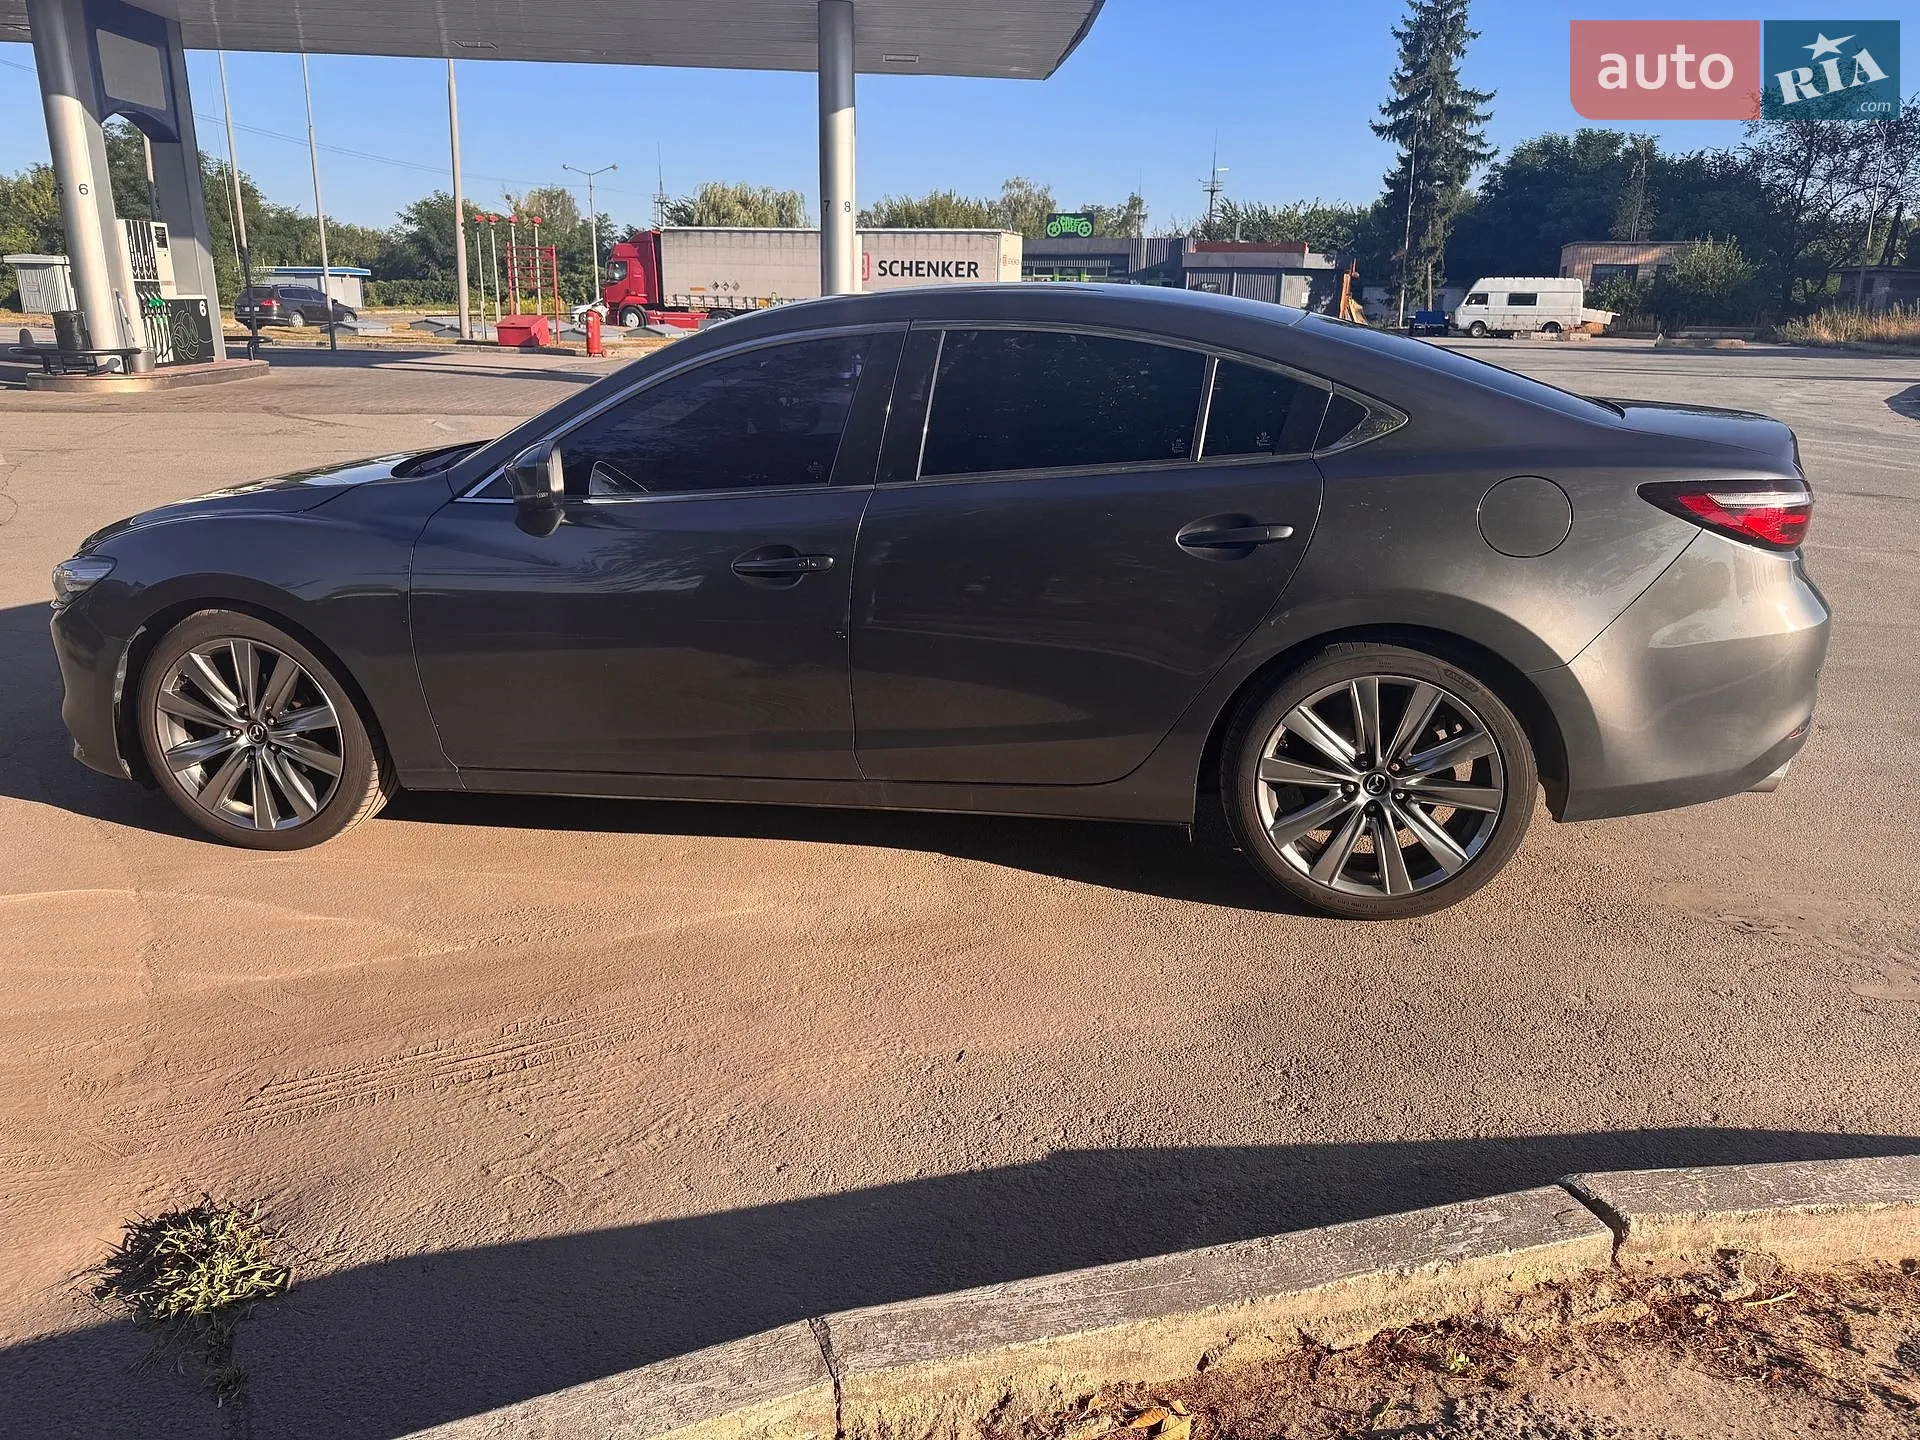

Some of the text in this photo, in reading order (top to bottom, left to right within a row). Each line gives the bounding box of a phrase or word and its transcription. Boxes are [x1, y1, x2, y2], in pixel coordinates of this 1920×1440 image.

[78, 183, 89, 196] 6
[823, 199, 831, 213] 7
[844, 200, 851, 213] 8
[877, 260, 980, 278] SCHENKER
[199, 300, 207, 317] 6
